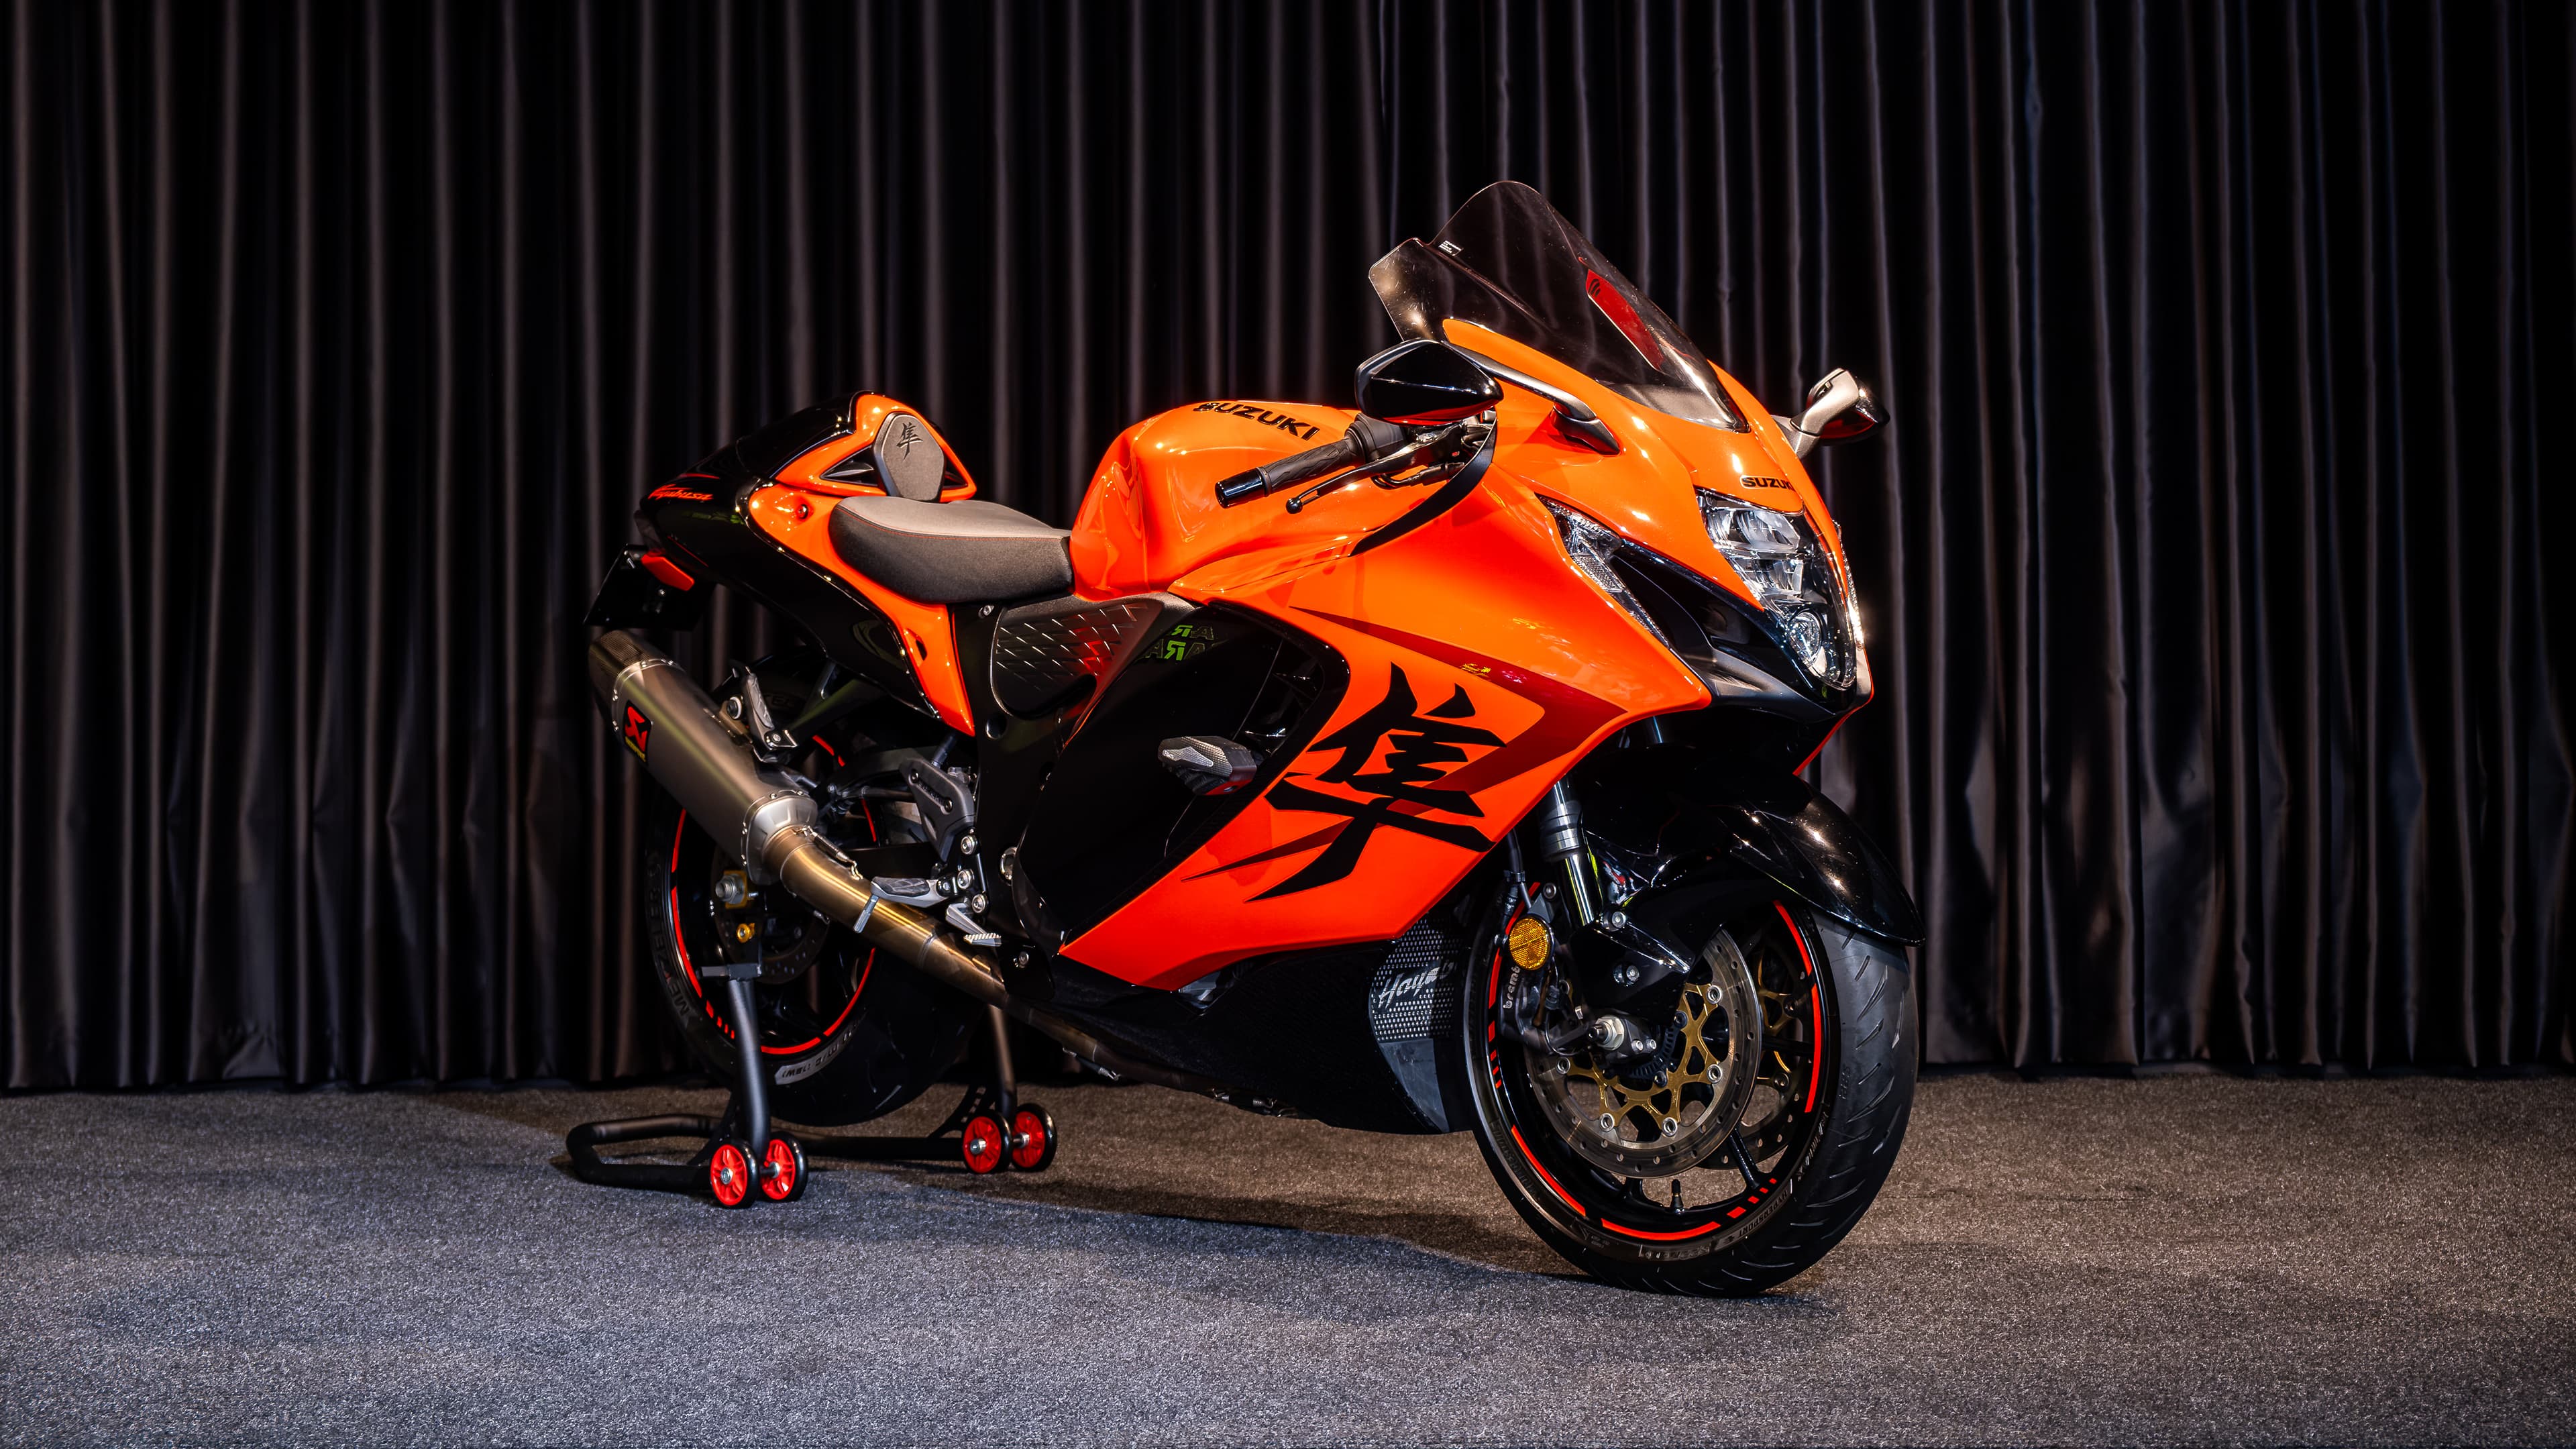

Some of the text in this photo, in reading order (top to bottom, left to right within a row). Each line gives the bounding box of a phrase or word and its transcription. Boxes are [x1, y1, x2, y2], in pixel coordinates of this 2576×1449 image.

[896, 421, 923, 460] 隼
[1193, 402, 1320, 441] SUZUKI
[1741, 476, 1796, 492] SUZUK
[1244, 661, 1498, 902] 隼
[1502, 965, 1521, 1009] bremb
